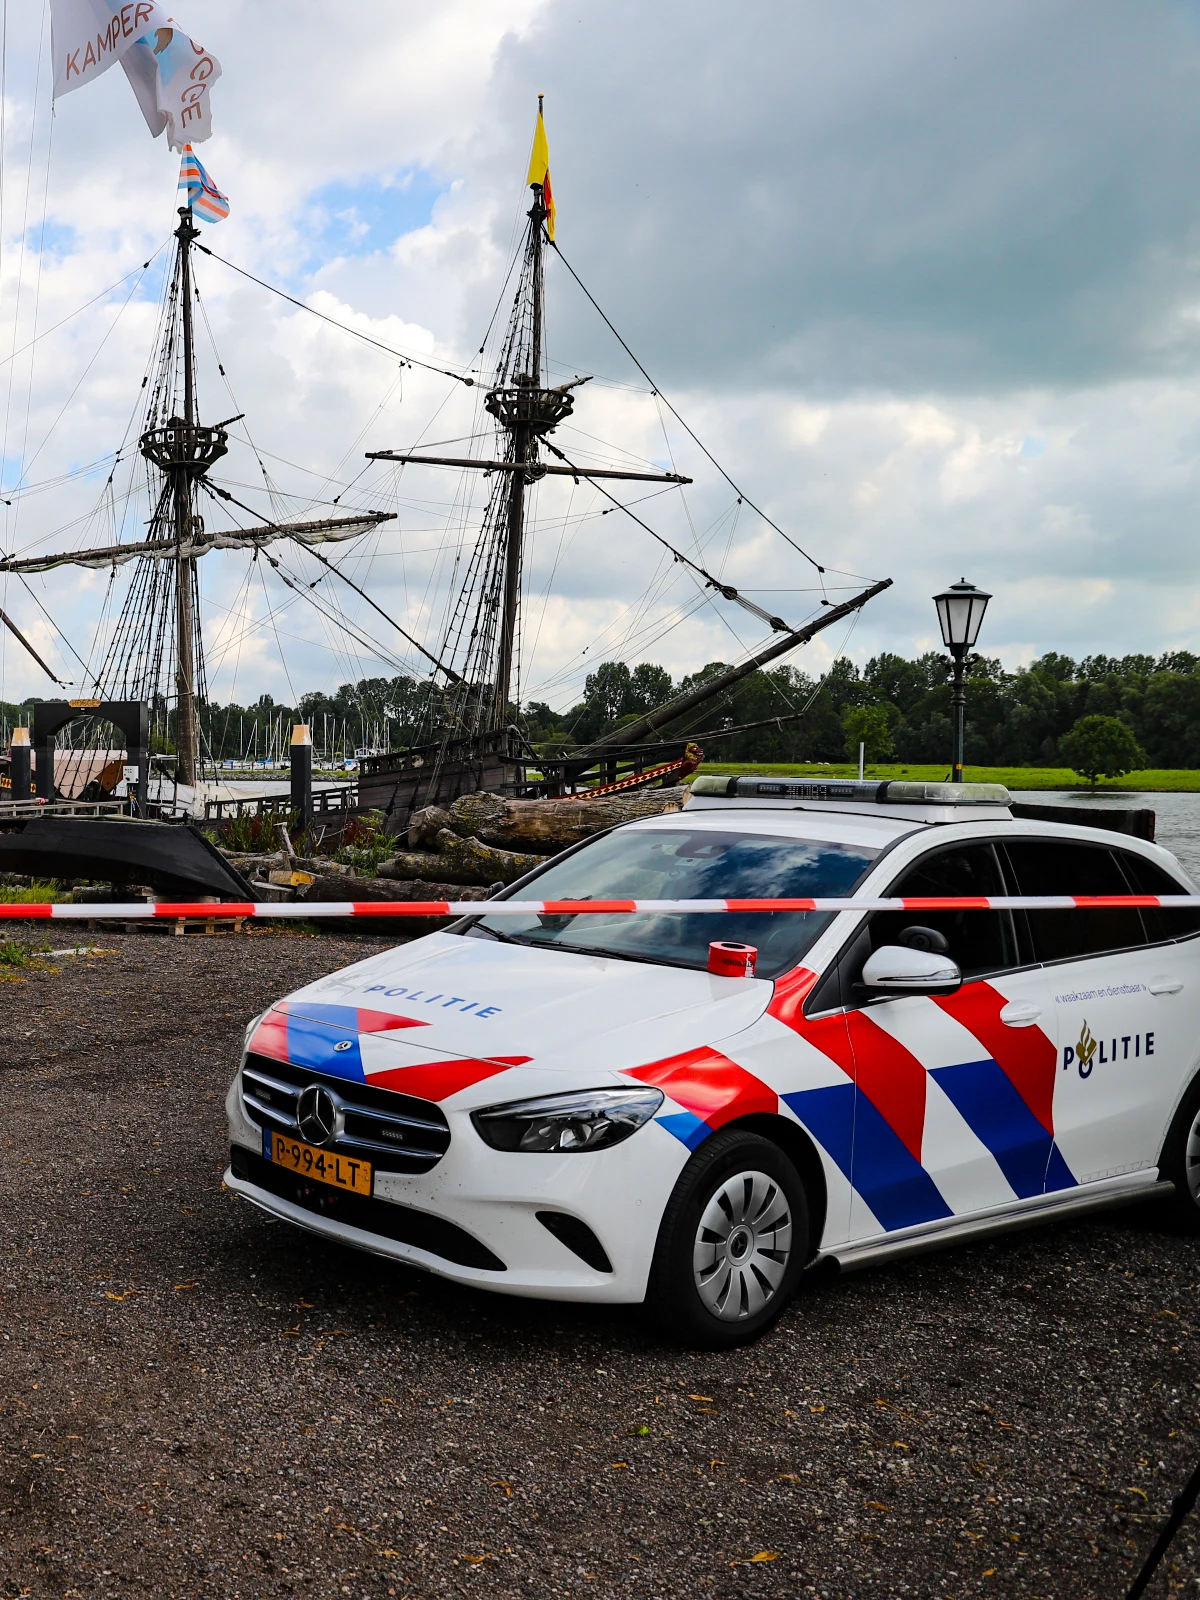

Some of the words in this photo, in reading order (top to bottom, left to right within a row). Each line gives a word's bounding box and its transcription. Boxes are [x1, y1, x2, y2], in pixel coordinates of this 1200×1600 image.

[66, 2, 154, 80] KAMPER
[363, 984, 502, 1019] POLITIE
[1060, 990, 1098, 1003] waakzaam
[1098, 989, 1107, 998] en
[1106, 983, 1141, 997] dienstbaar
[1063, 1032, 1155, 1079] POLITIE
[275, 1137, 361, 1187] P-994-LT
